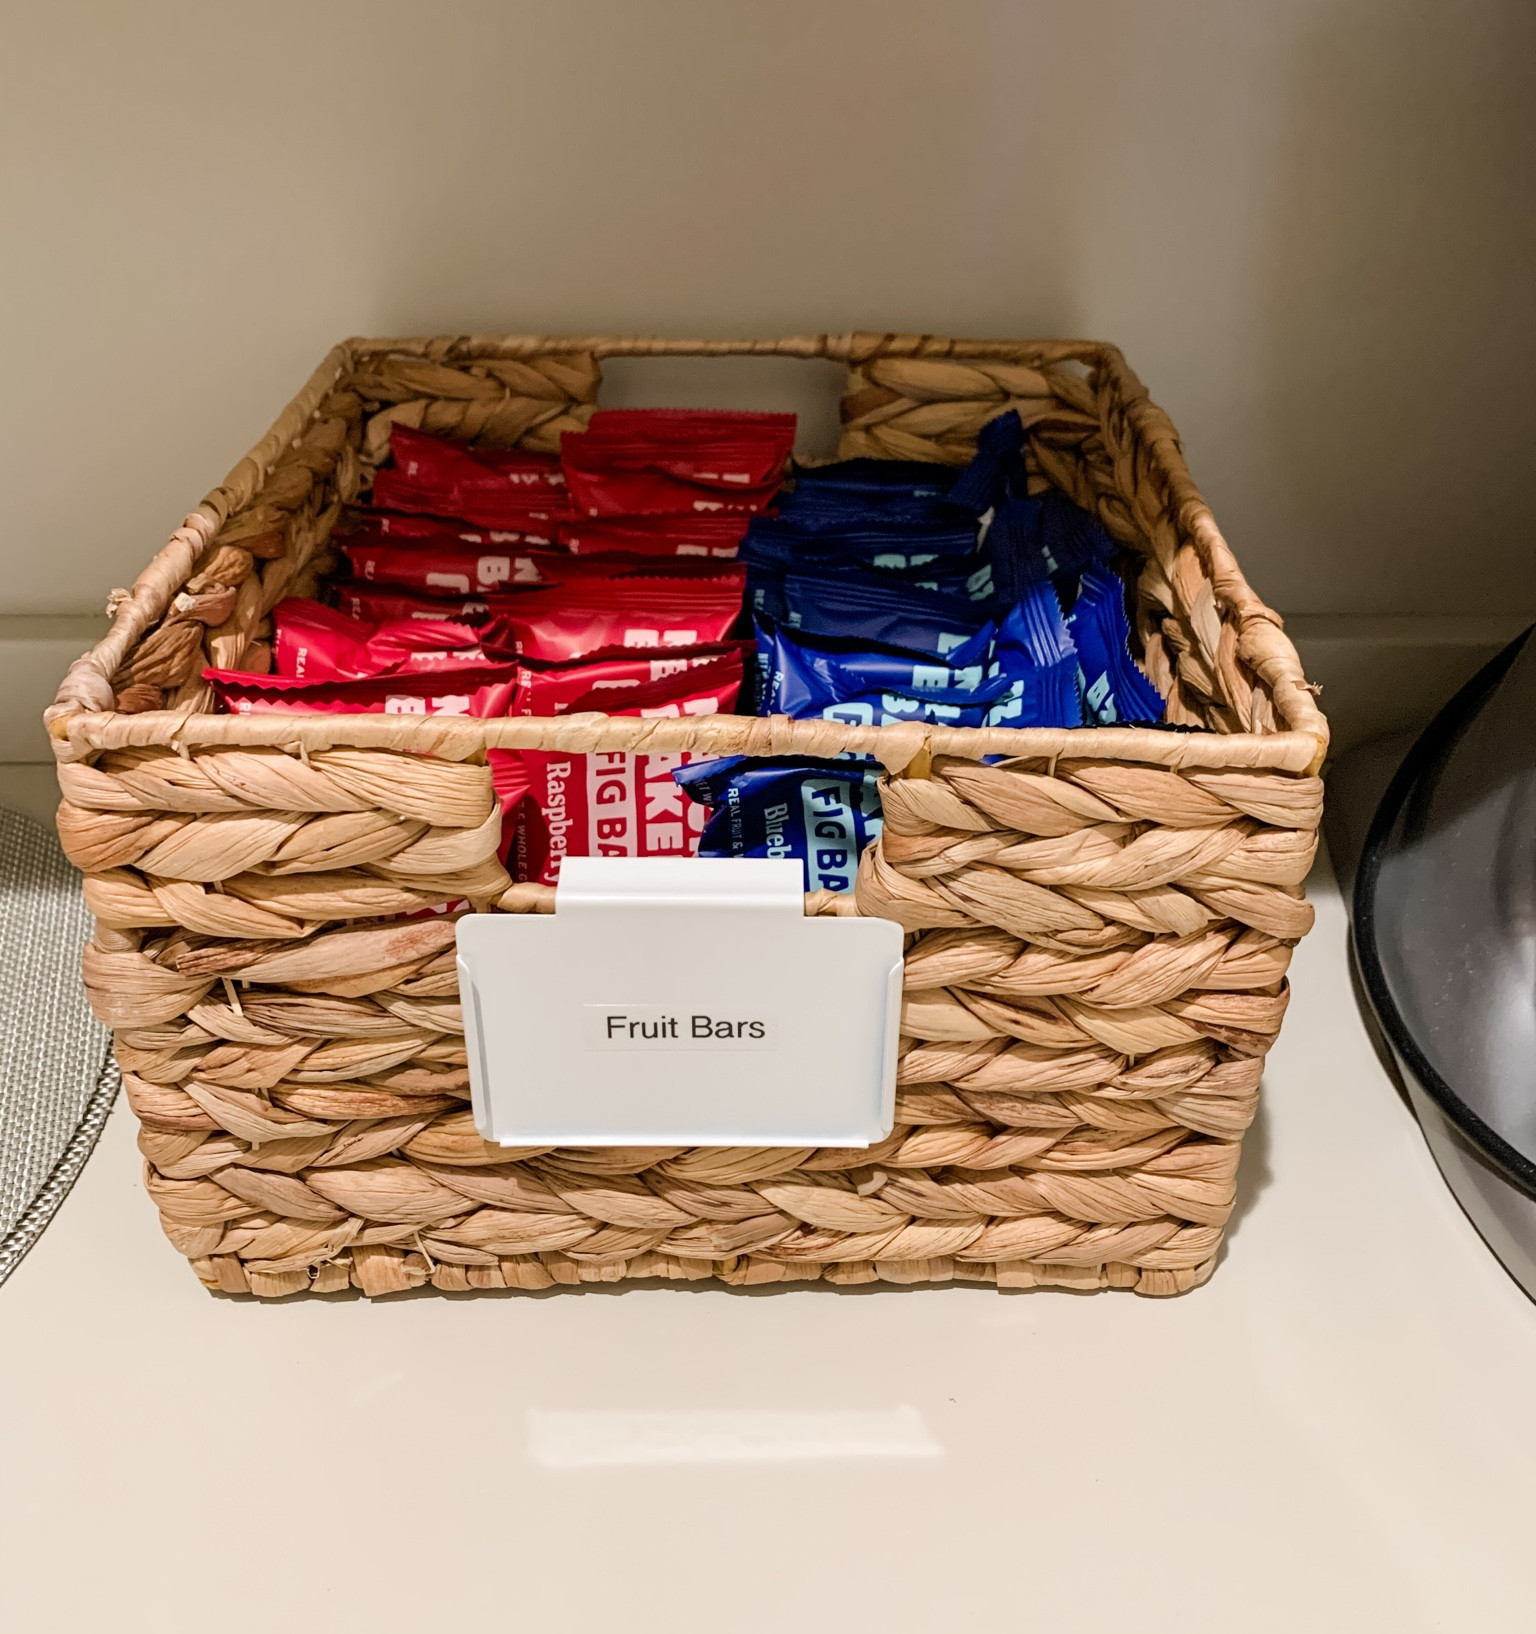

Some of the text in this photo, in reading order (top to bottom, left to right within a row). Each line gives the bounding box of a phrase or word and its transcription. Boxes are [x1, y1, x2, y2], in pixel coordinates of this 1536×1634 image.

[595, 752, 627, 805] FIG
[728, 787, 741, 818] REAL
[812, 786, 847, 840] FIG
[541, 761, 574, 883] Raspberry
[731, 818, 743, 839] FRUIT
[517, 825, 527, 870] WHOLE
[732, 841, 743, 850] &
[606, 1015, 766, 1039] Fruit Bars
